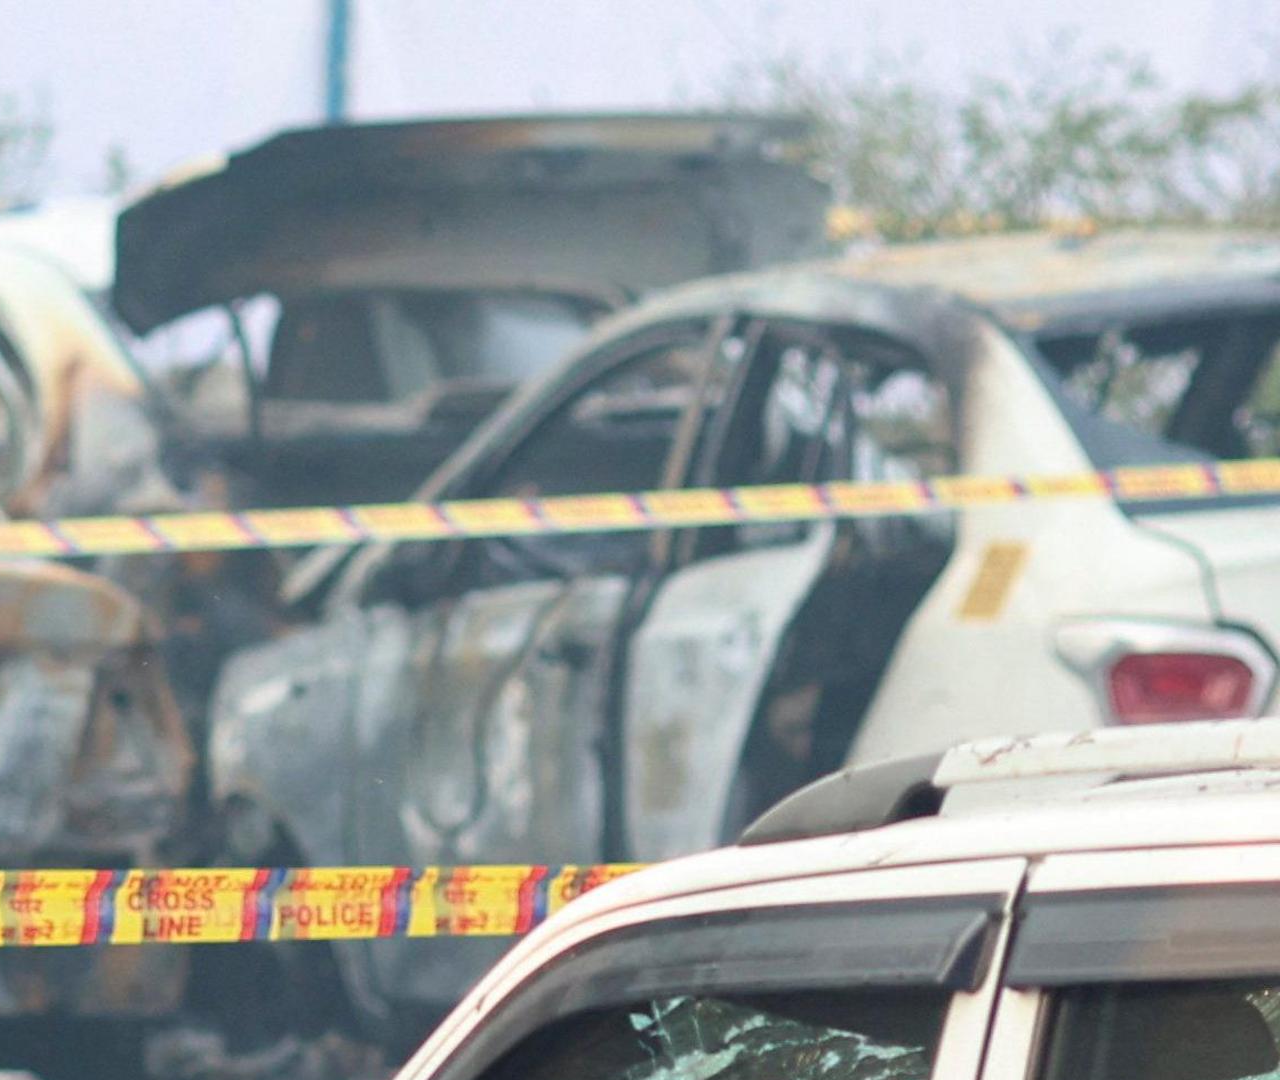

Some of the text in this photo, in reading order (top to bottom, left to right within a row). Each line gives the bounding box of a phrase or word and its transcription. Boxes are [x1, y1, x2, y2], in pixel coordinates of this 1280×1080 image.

[127, 889, 214, 911] CROSS
[279, 903, 374, 927] POLICE
[143, 916, 201, 938] LINE
